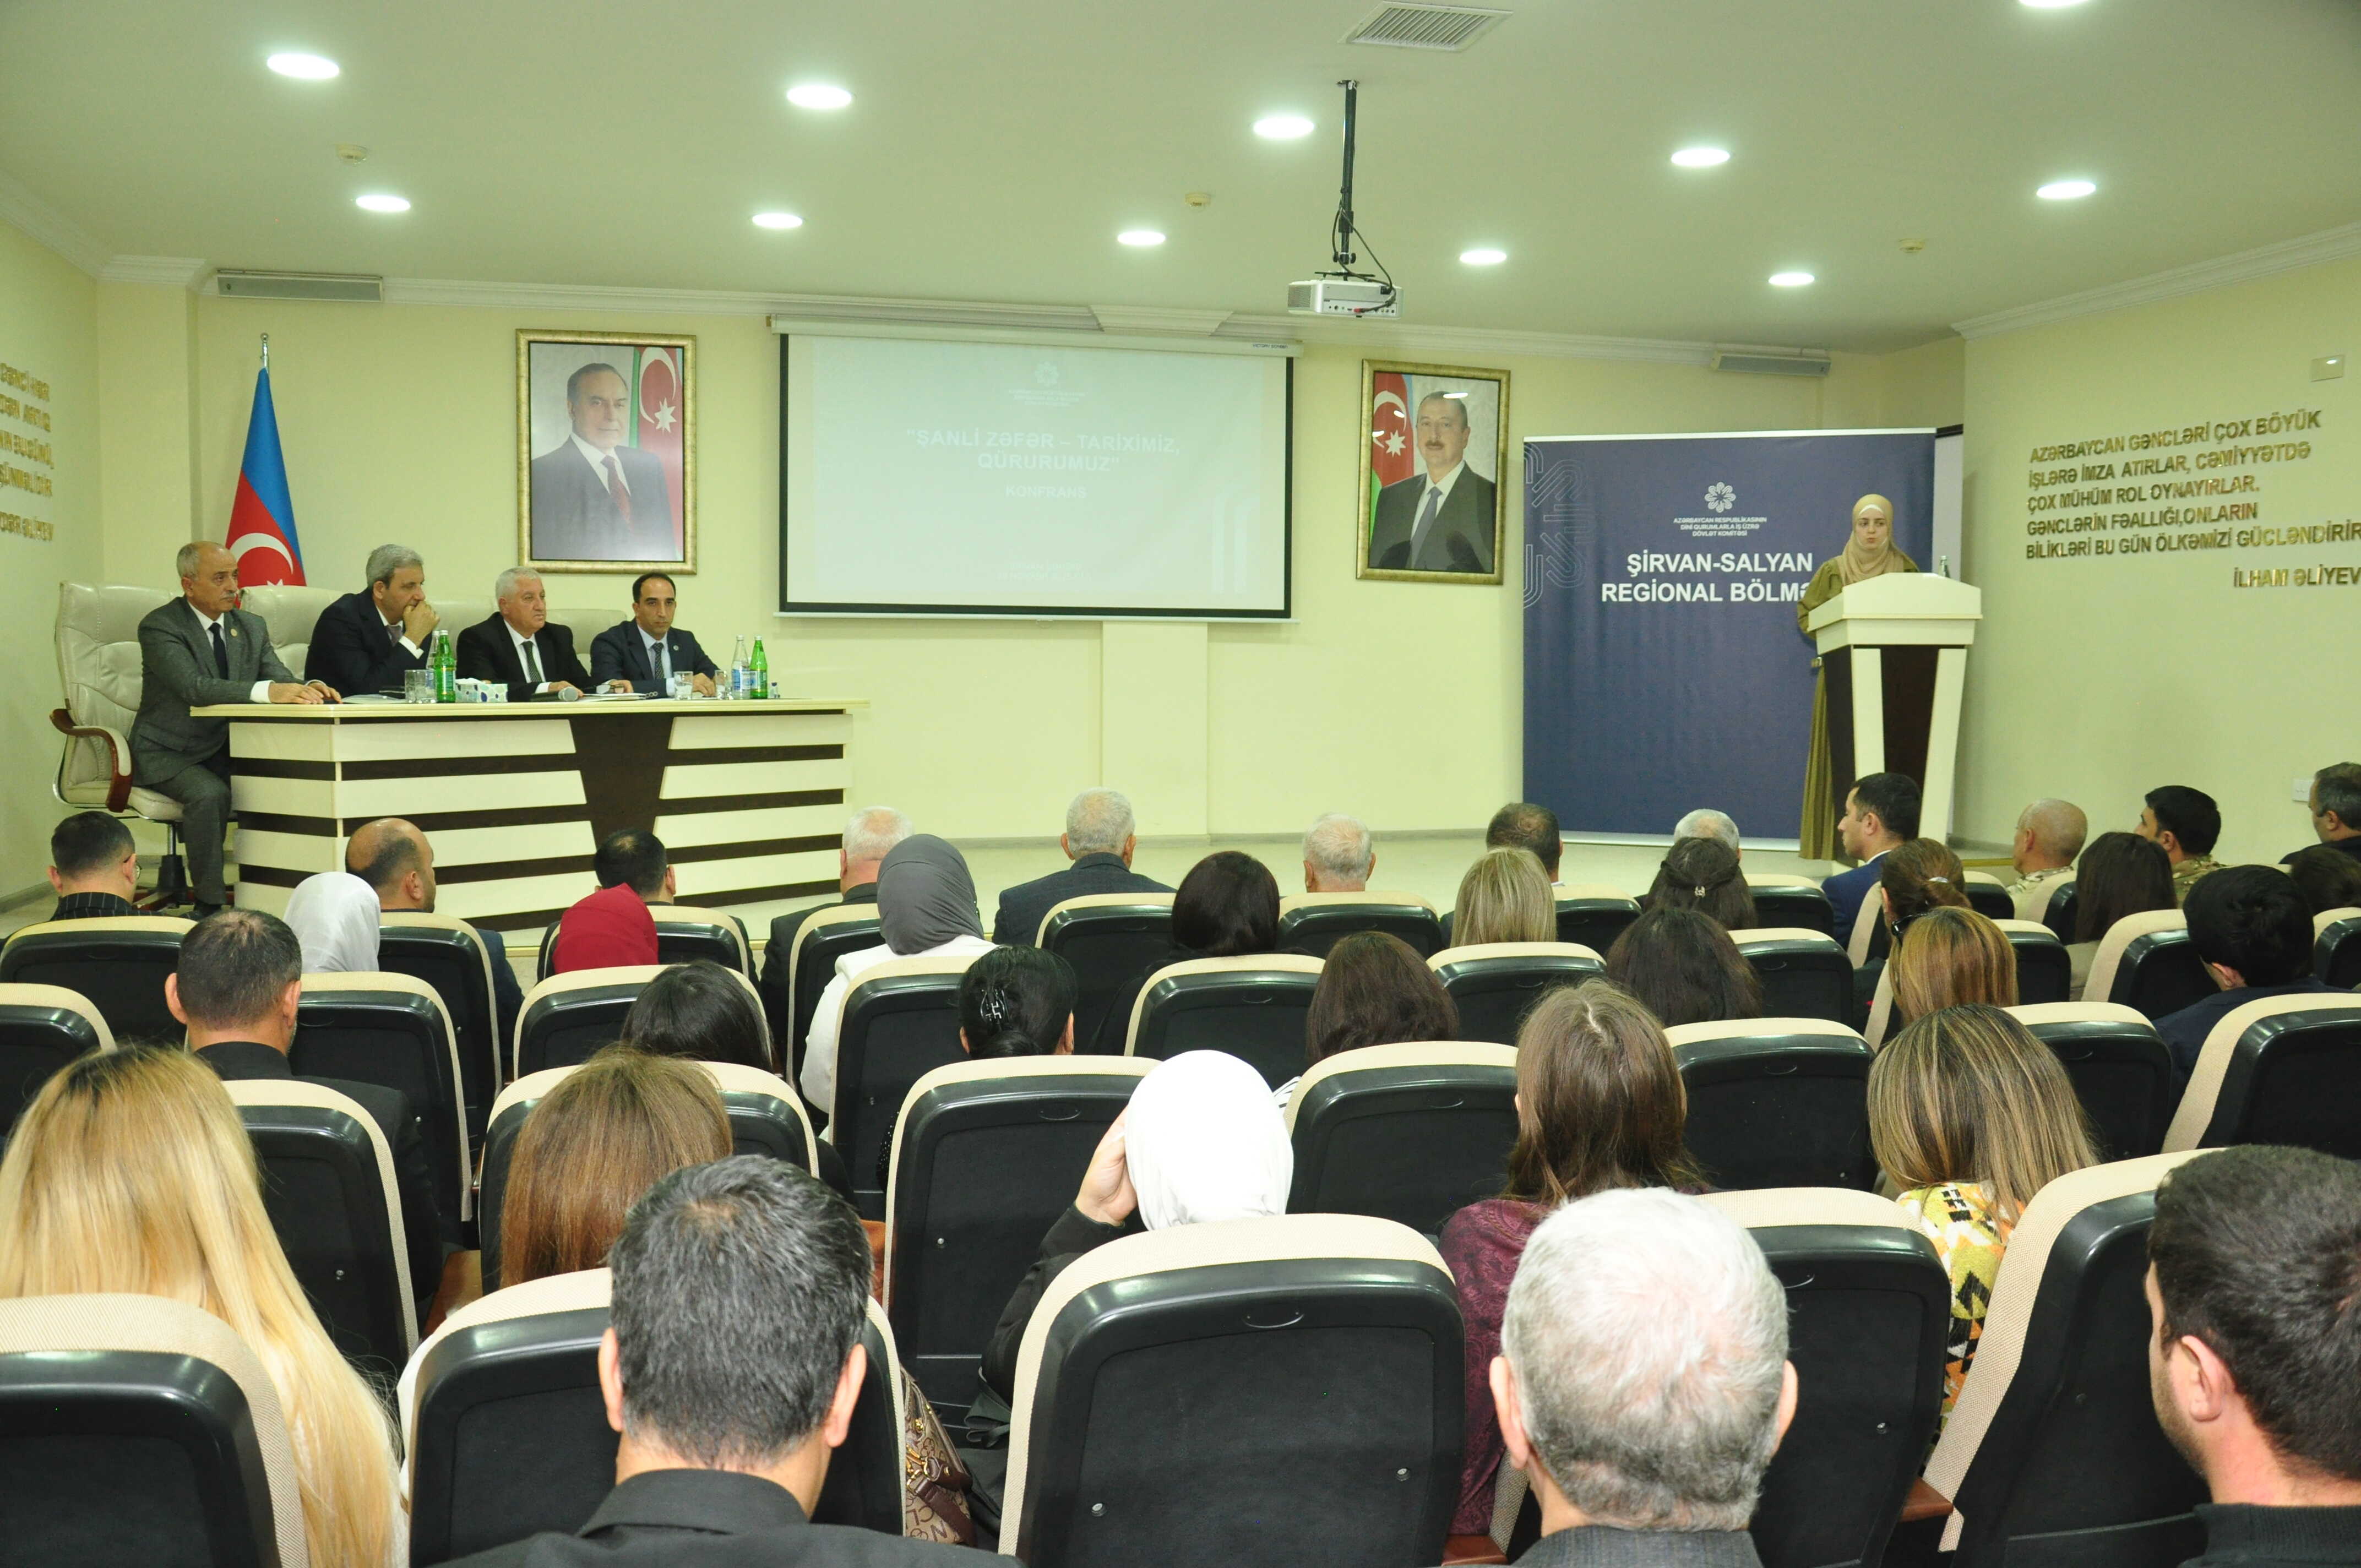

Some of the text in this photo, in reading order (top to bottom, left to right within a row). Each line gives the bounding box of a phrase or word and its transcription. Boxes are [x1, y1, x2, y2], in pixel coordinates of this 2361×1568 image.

[986, 431, 1054, 449] ZƏFƏR
[2030, 409, 2322, 463] AZƏRBAYCAN GƏNCLƏRİ ÇOX BÖYÜK
[2028, 441, 2311, 491] İŞLƏRƏ İMZA ATIRLAR, CƏMİYYƏTDƏ
[1006, 484, 1087, 498] KONFRANS
[2027, 475, 2260, 515] ÇOX MÜHÜM ROL OYNAYIRLAR.
[2027, 512, 2107, 536] GƏNCLƏRİN
[2026, 537, 2092, 559] BİLİKLƏRİ
[2095, 539, 2115, 556] BU
[2119, 534, 2151, 554] GÜN
[2156, 527, 2233, 552] ÖLKƏMİZİ
[1626, 549, 1813, 578] ŞİRVAN-SALYAN
[2234, 563, 2361, 588] İLHAM ƏLİYEV
[1602, 578, 1723, 602] REGİONAL
